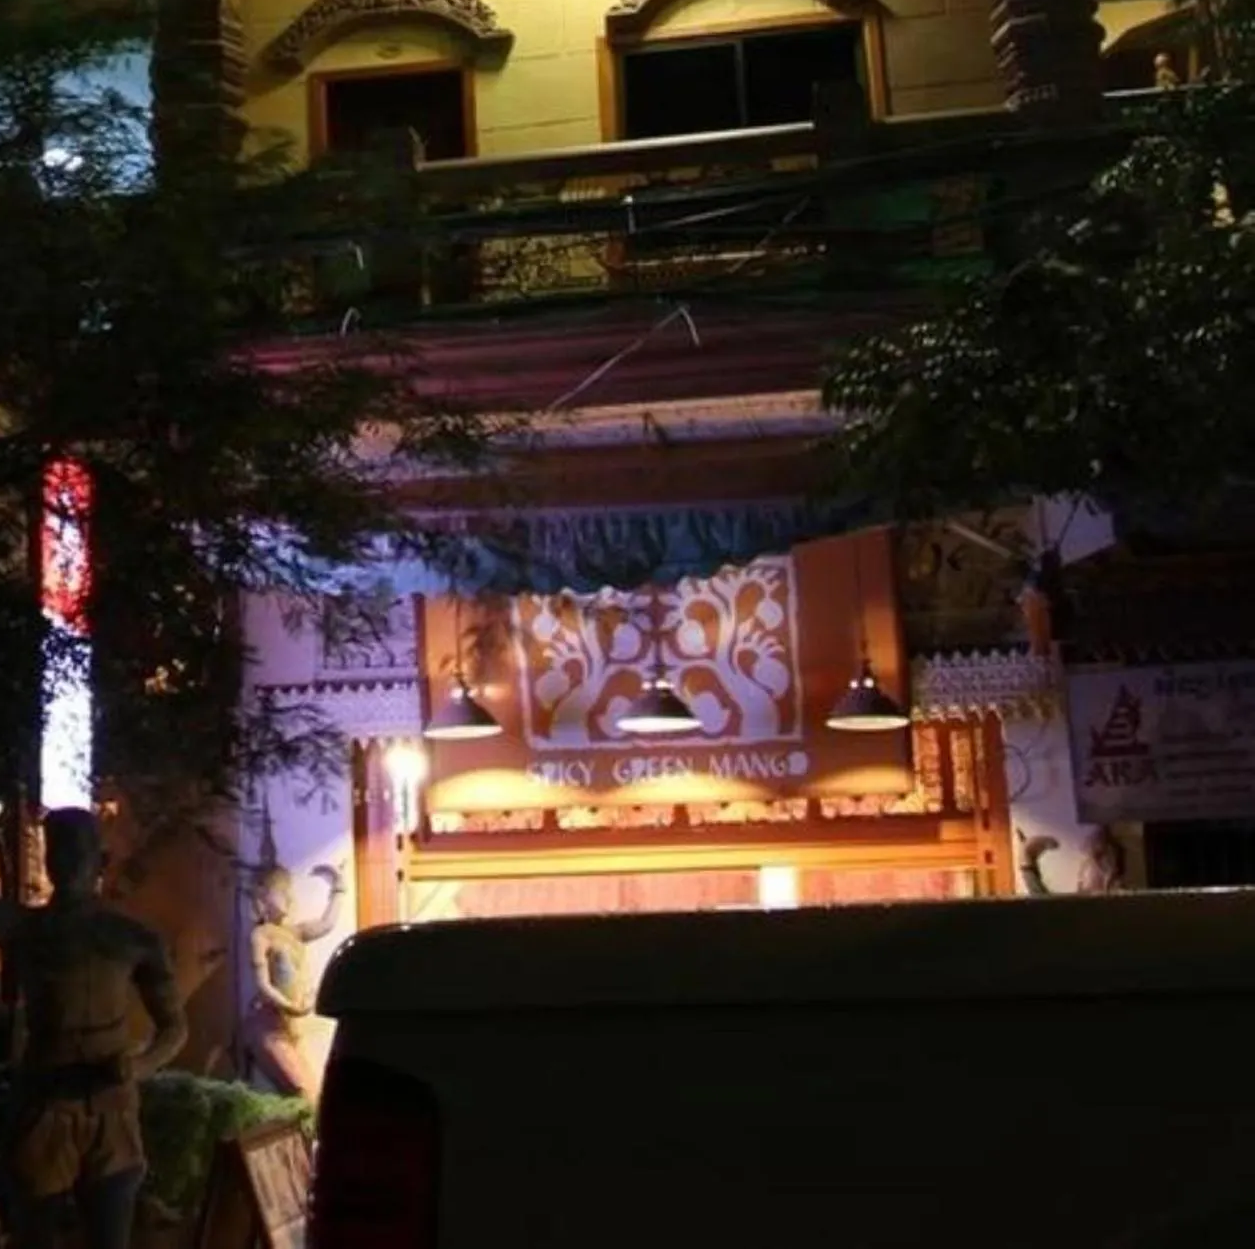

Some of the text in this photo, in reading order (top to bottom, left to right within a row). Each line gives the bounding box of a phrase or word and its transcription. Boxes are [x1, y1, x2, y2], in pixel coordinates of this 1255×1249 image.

[527, 751, 809, 786] SPICY GREEN MANGO
